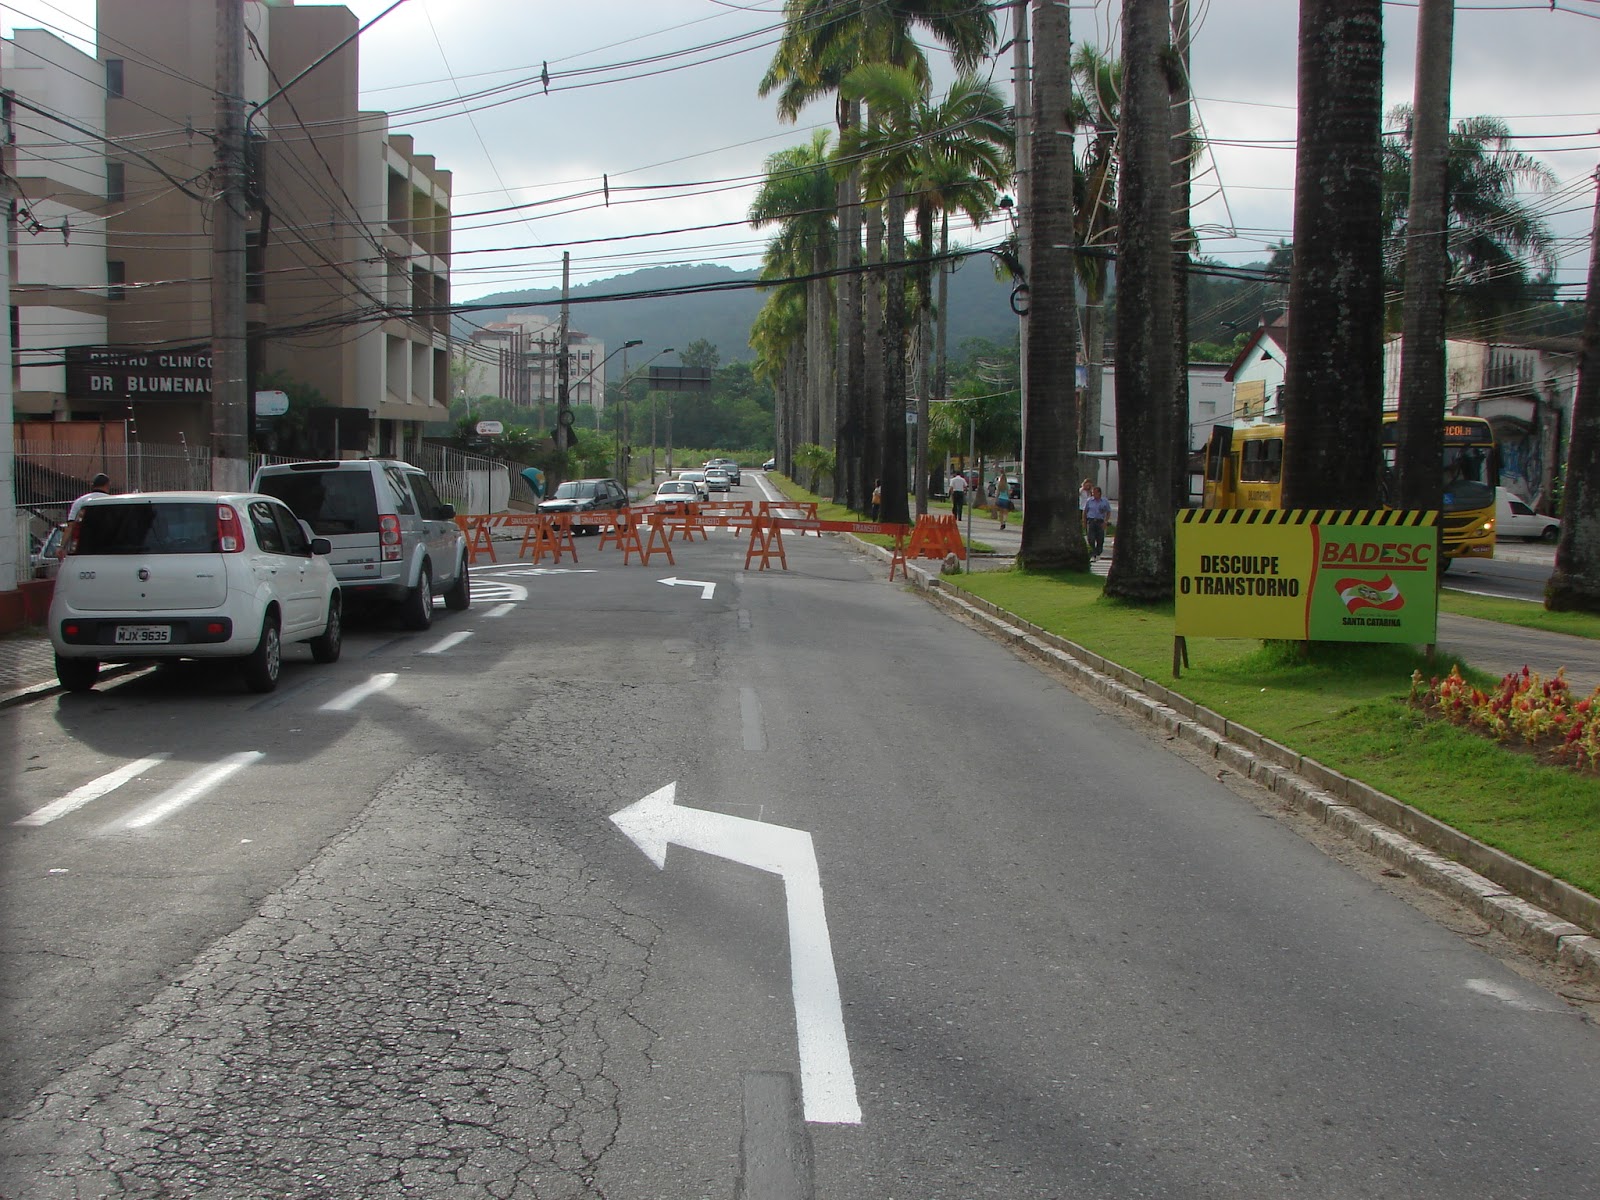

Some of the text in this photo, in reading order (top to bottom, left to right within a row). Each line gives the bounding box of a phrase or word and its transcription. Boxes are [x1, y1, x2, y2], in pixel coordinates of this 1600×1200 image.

[90, 376, 213, 393] DR BLUMENAU
[1321, 543, 1431, 564] BADESC
[1200, 555, 1279, 575] DESCULPE
[1180, 576, 1299, 597] O TRANSTORNO
[1341, 616, 1401, 628] SANTA CATARINA
[118, 631, 168, 641] MJX-9635
